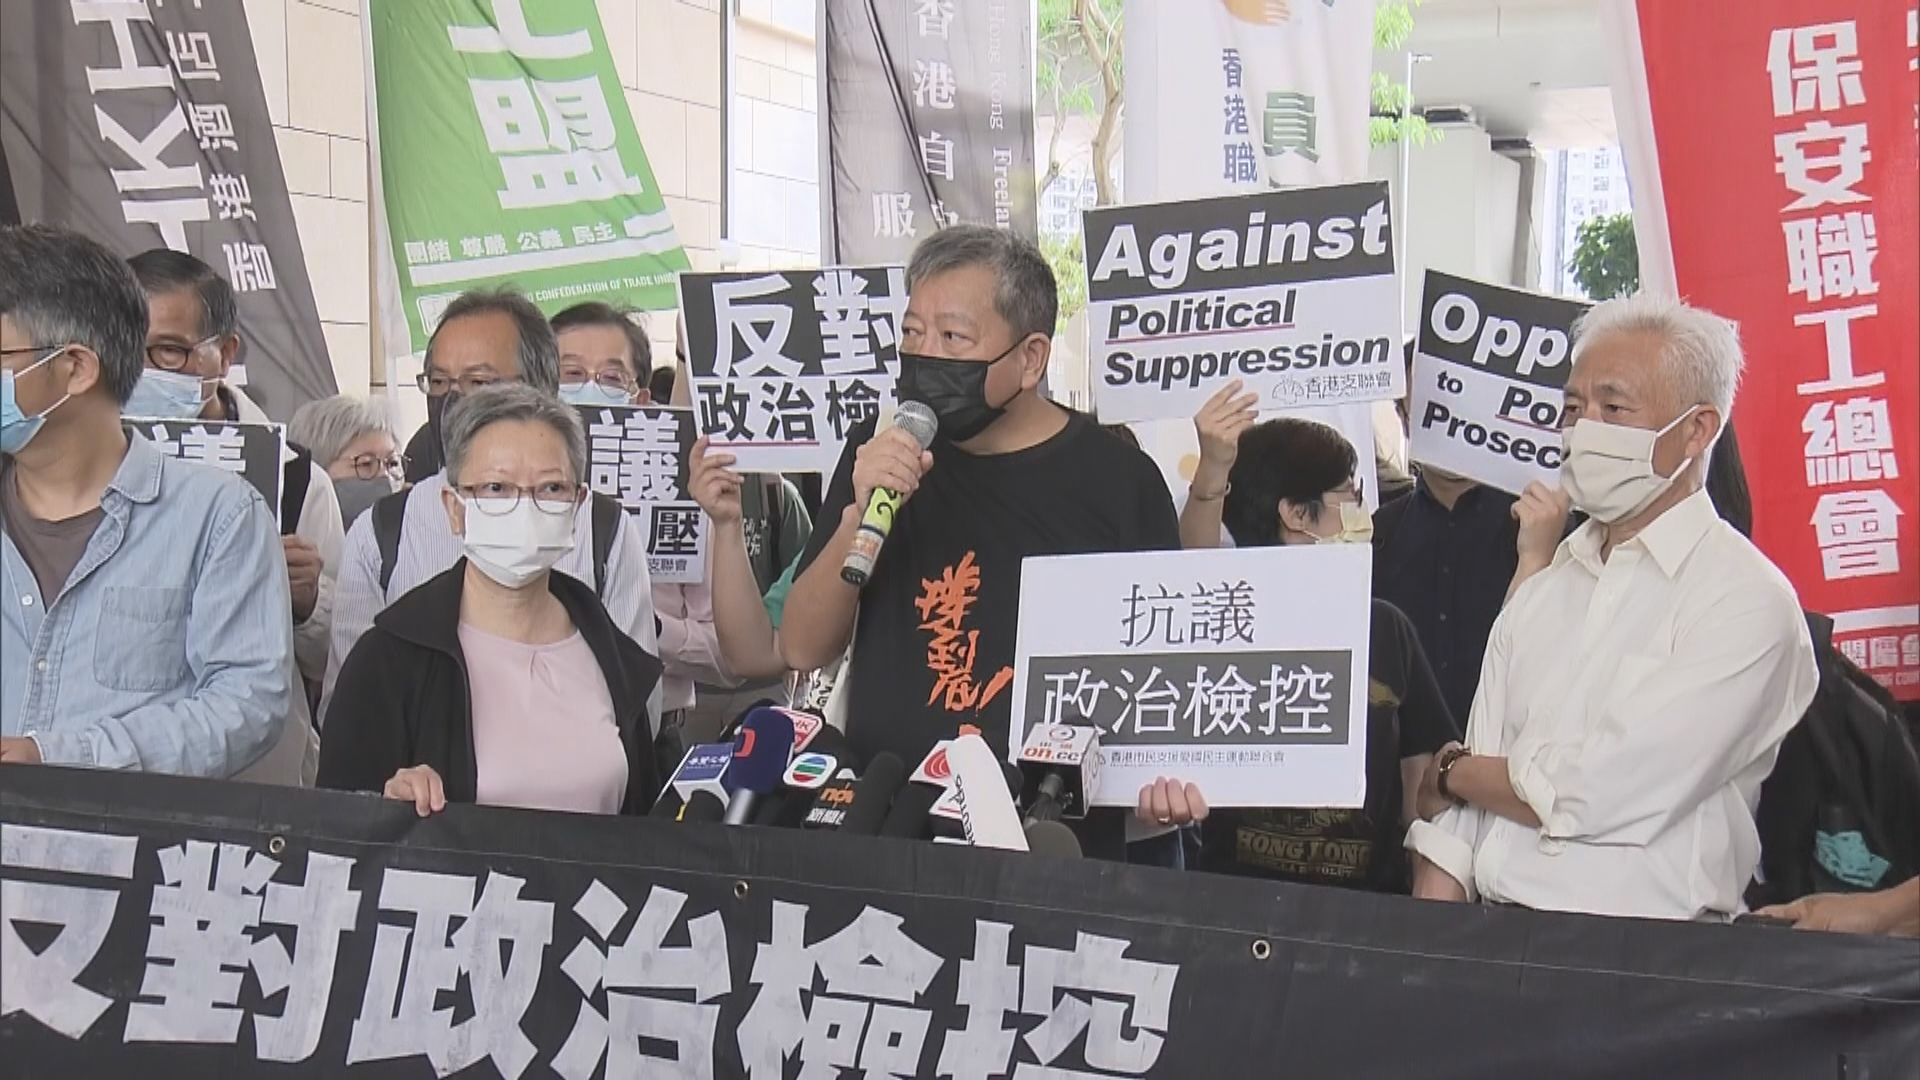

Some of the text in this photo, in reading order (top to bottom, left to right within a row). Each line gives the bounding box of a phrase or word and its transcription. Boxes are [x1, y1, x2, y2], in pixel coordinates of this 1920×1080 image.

[153, 0, 277, 292] 香港酒店
[1222, 48, 1258, 183] 香港職
[572, 222, 617, 246] 民主
[1091, 199, 1389, 290] Against
[536, 281, 609, 302] CONFEDERATION
[610, 277, 621, 291] OF
[623, 273, 653, 288] TRADE
[711, 270, 910, 378] 反對
[1107, 288, 1298, 340] Political
[1766, 20, 1905, 581] 保安職工總會
[1104, 333, 1391, 391] Suppression
[1430, 293, 1573, 376] Opp
[697, 377, 900, 442] 政治檢
[1436, 370, 1463, 394] to
[589, 408, 680, 500] 議
[1119, 579, 1256, 647] 抗議
[1043, 663, 1335, 738] 政治檢控
[0, 823, 1180, 1080] 反對政治檢控
